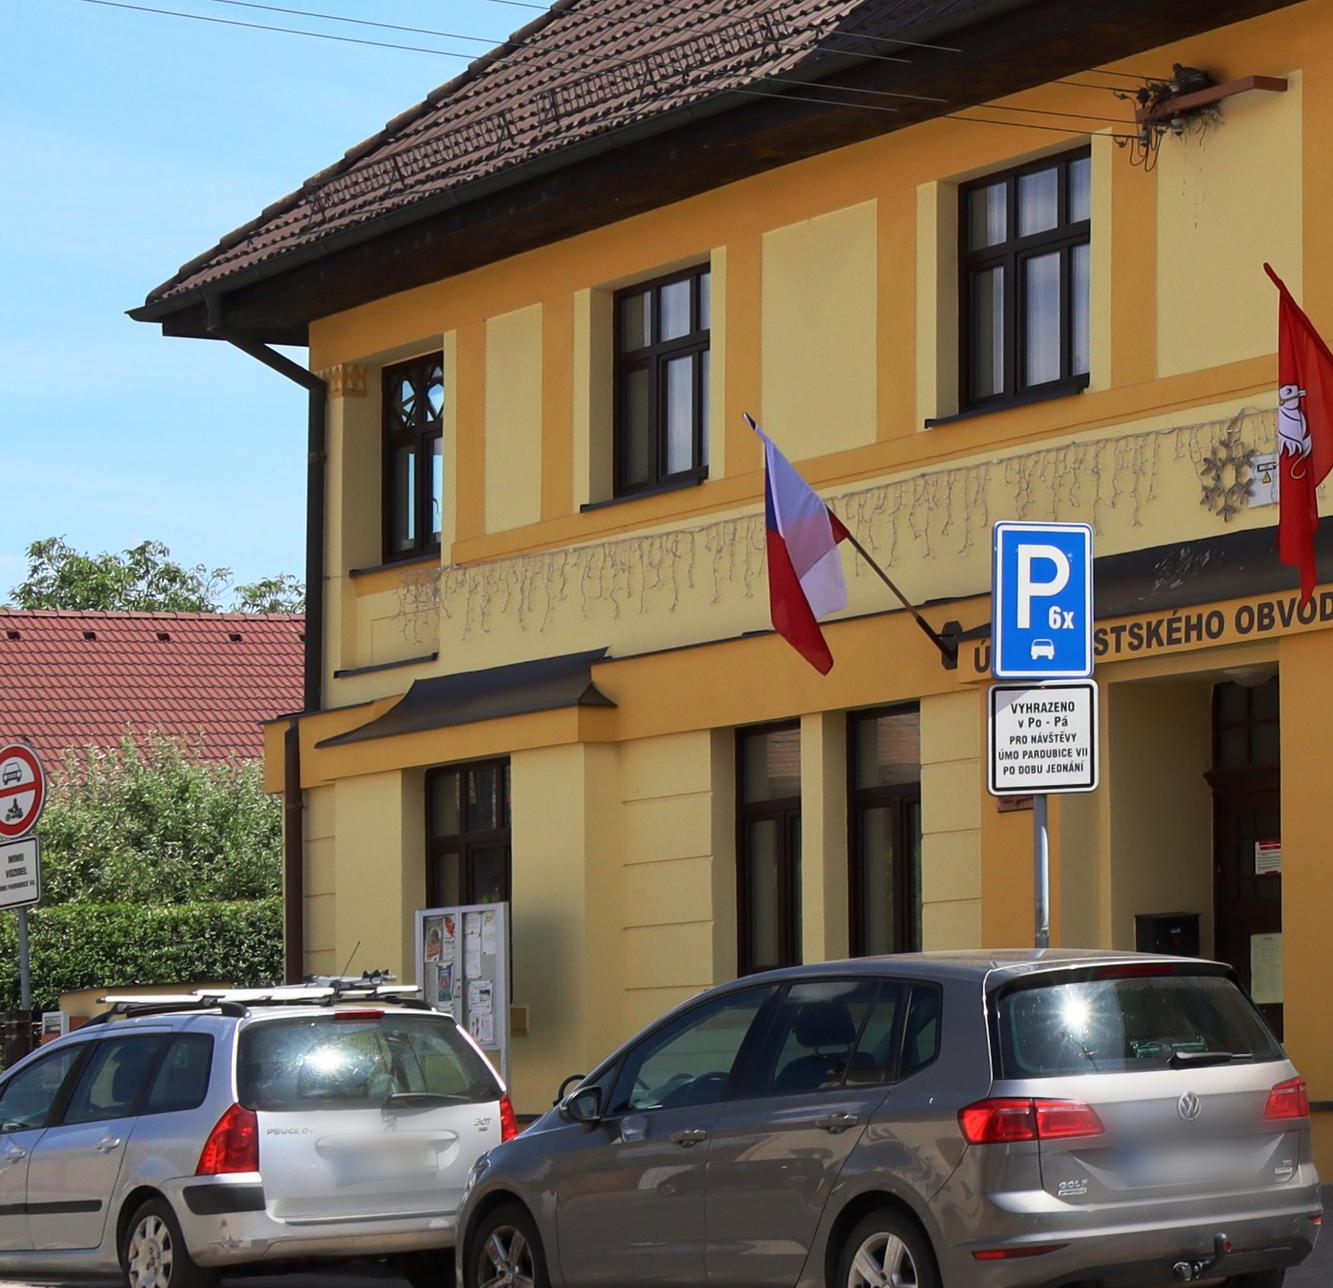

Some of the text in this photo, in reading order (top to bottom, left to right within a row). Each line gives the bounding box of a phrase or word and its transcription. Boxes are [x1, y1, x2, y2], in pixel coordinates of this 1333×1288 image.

[1017, 544, 1070, 629] P
[1048, 605, 1075, 630] 6x
[1094, 609, 1225, 657] STSKÉHO
[1011, 700, 1075, 714] VYHRAZENO
[1018, 719, 1024, 728] v
[1028, 716, 1042, 728] Po
[1054, 714, 1068, 727] Pá
[1009, 732, 1076, 745] PRO NÁVŠTĚVY
[998, 747, 1088, 760] ÚMO PARDUBICE VII
[1003, 761, 1084, 775] PO DOBU JEDNÁNÍ
